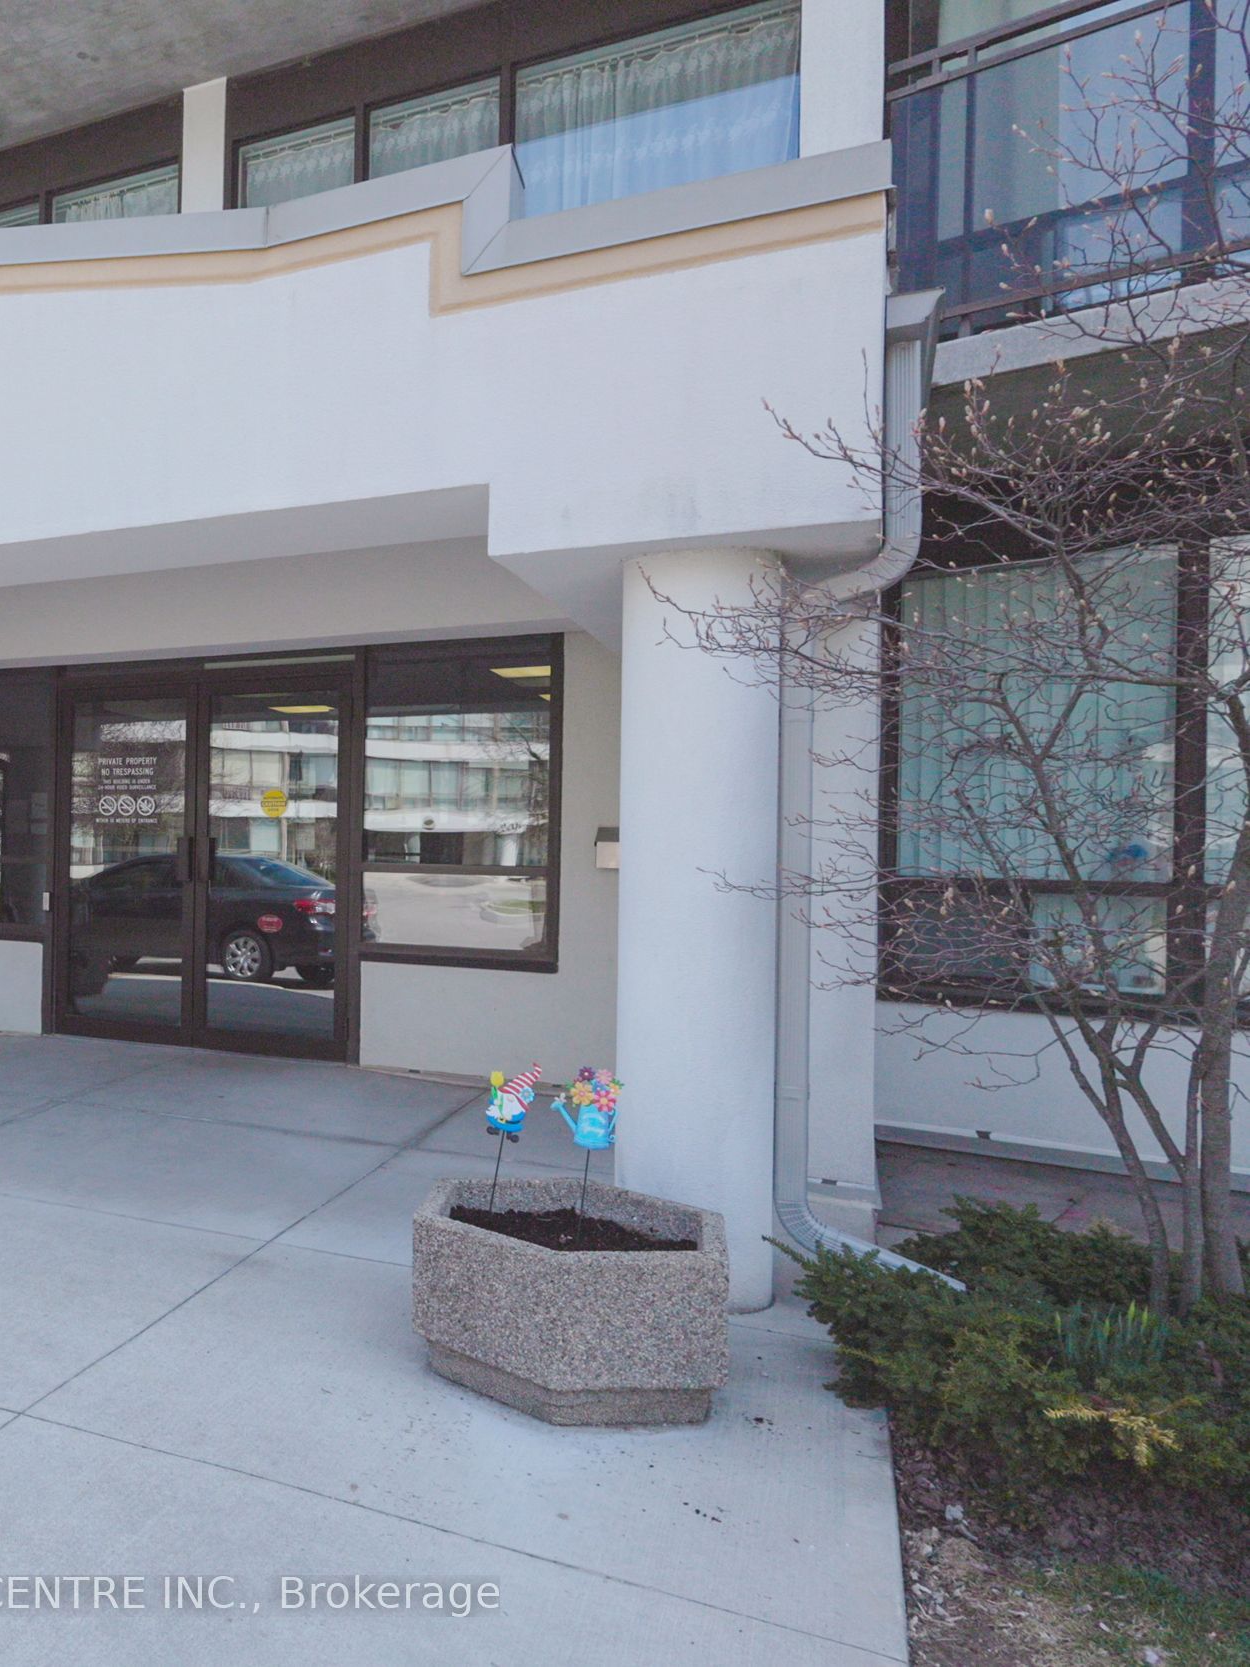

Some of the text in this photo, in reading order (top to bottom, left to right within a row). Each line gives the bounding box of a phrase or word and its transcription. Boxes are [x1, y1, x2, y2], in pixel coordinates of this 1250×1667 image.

[98, 756, 157, 766] PRIVATE PROPERTY
[101, 767, 154, 777] NO TRESPASSING
